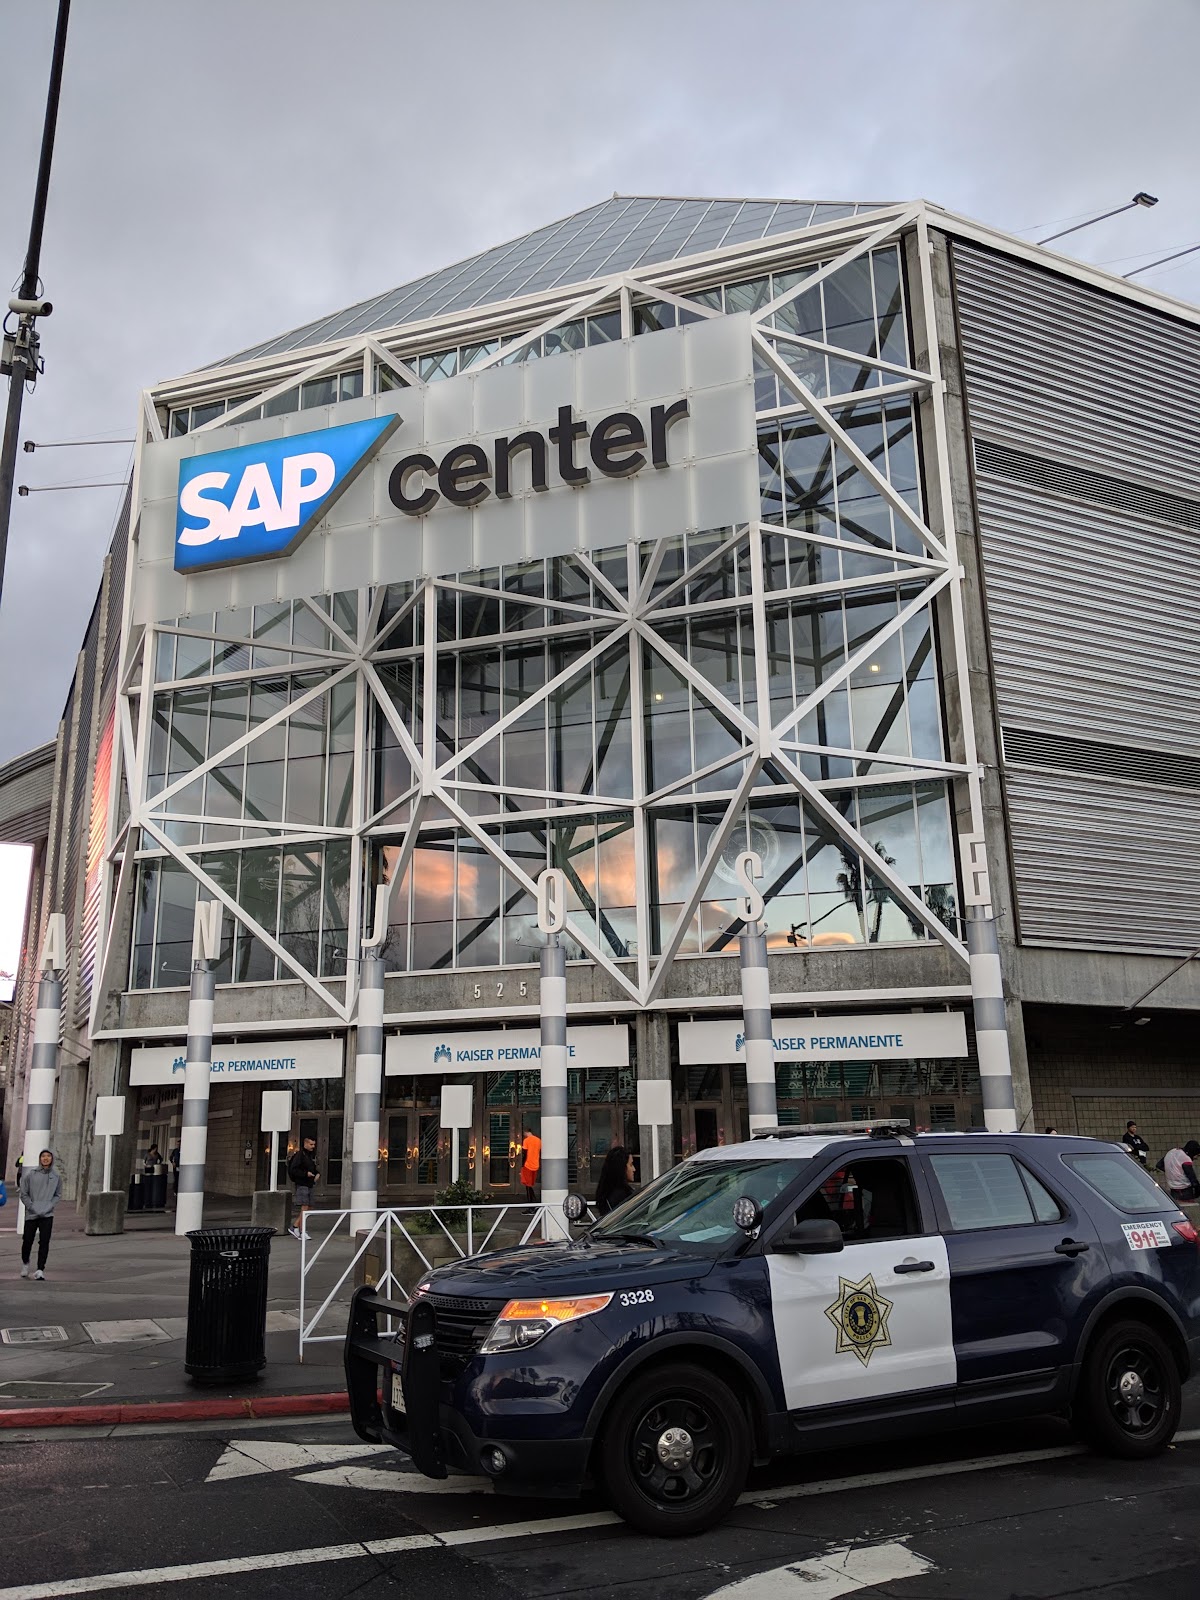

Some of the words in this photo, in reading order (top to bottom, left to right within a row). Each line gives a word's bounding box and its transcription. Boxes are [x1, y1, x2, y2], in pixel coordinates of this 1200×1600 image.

[177, 452, 336, 547] SAP
[388, 399, 690, 516] center
[772, 1037, 806, 1050] AISER
[811, 1034, 903, 1049] PERMANENTE
[456, 1049, 494, 1061] KAISER
[227, 1058, 296, 1072] PERMANENTE
[1123, 1222, 1162, 1231] EMERGENCY
[620, 1289, 655, 1306] 3328
[853, 1332, 872, 1340] POLICE
